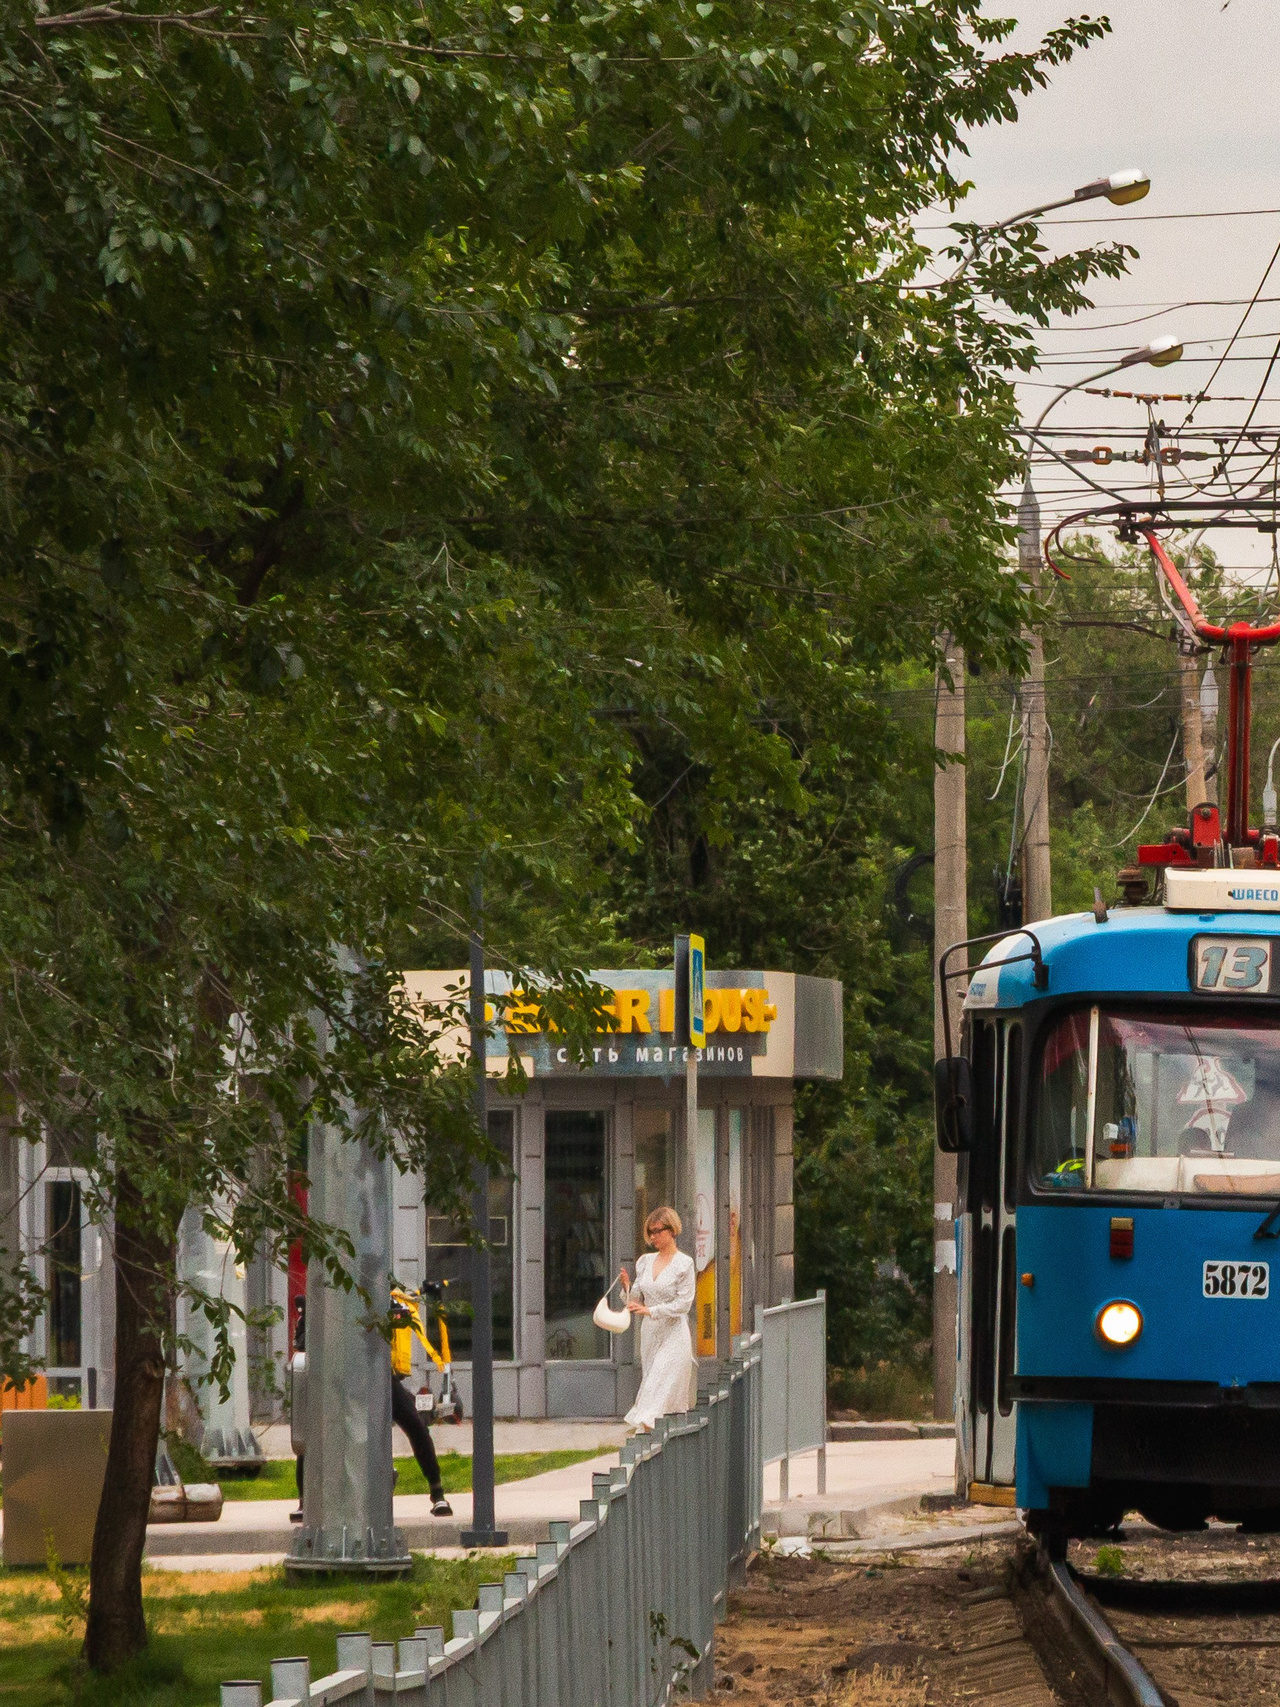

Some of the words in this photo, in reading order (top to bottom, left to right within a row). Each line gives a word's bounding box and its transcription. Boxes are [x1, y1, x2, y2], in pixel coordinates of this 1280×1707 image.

[1233, 888, 1279, 902] WAECO
[1201, 945, 1268, 989] 13
[556, 1047, 619, 1063] сть
[636, 1046, 744, 1063] магазинов
[1204, 1264, 1267, 1297] 5872
